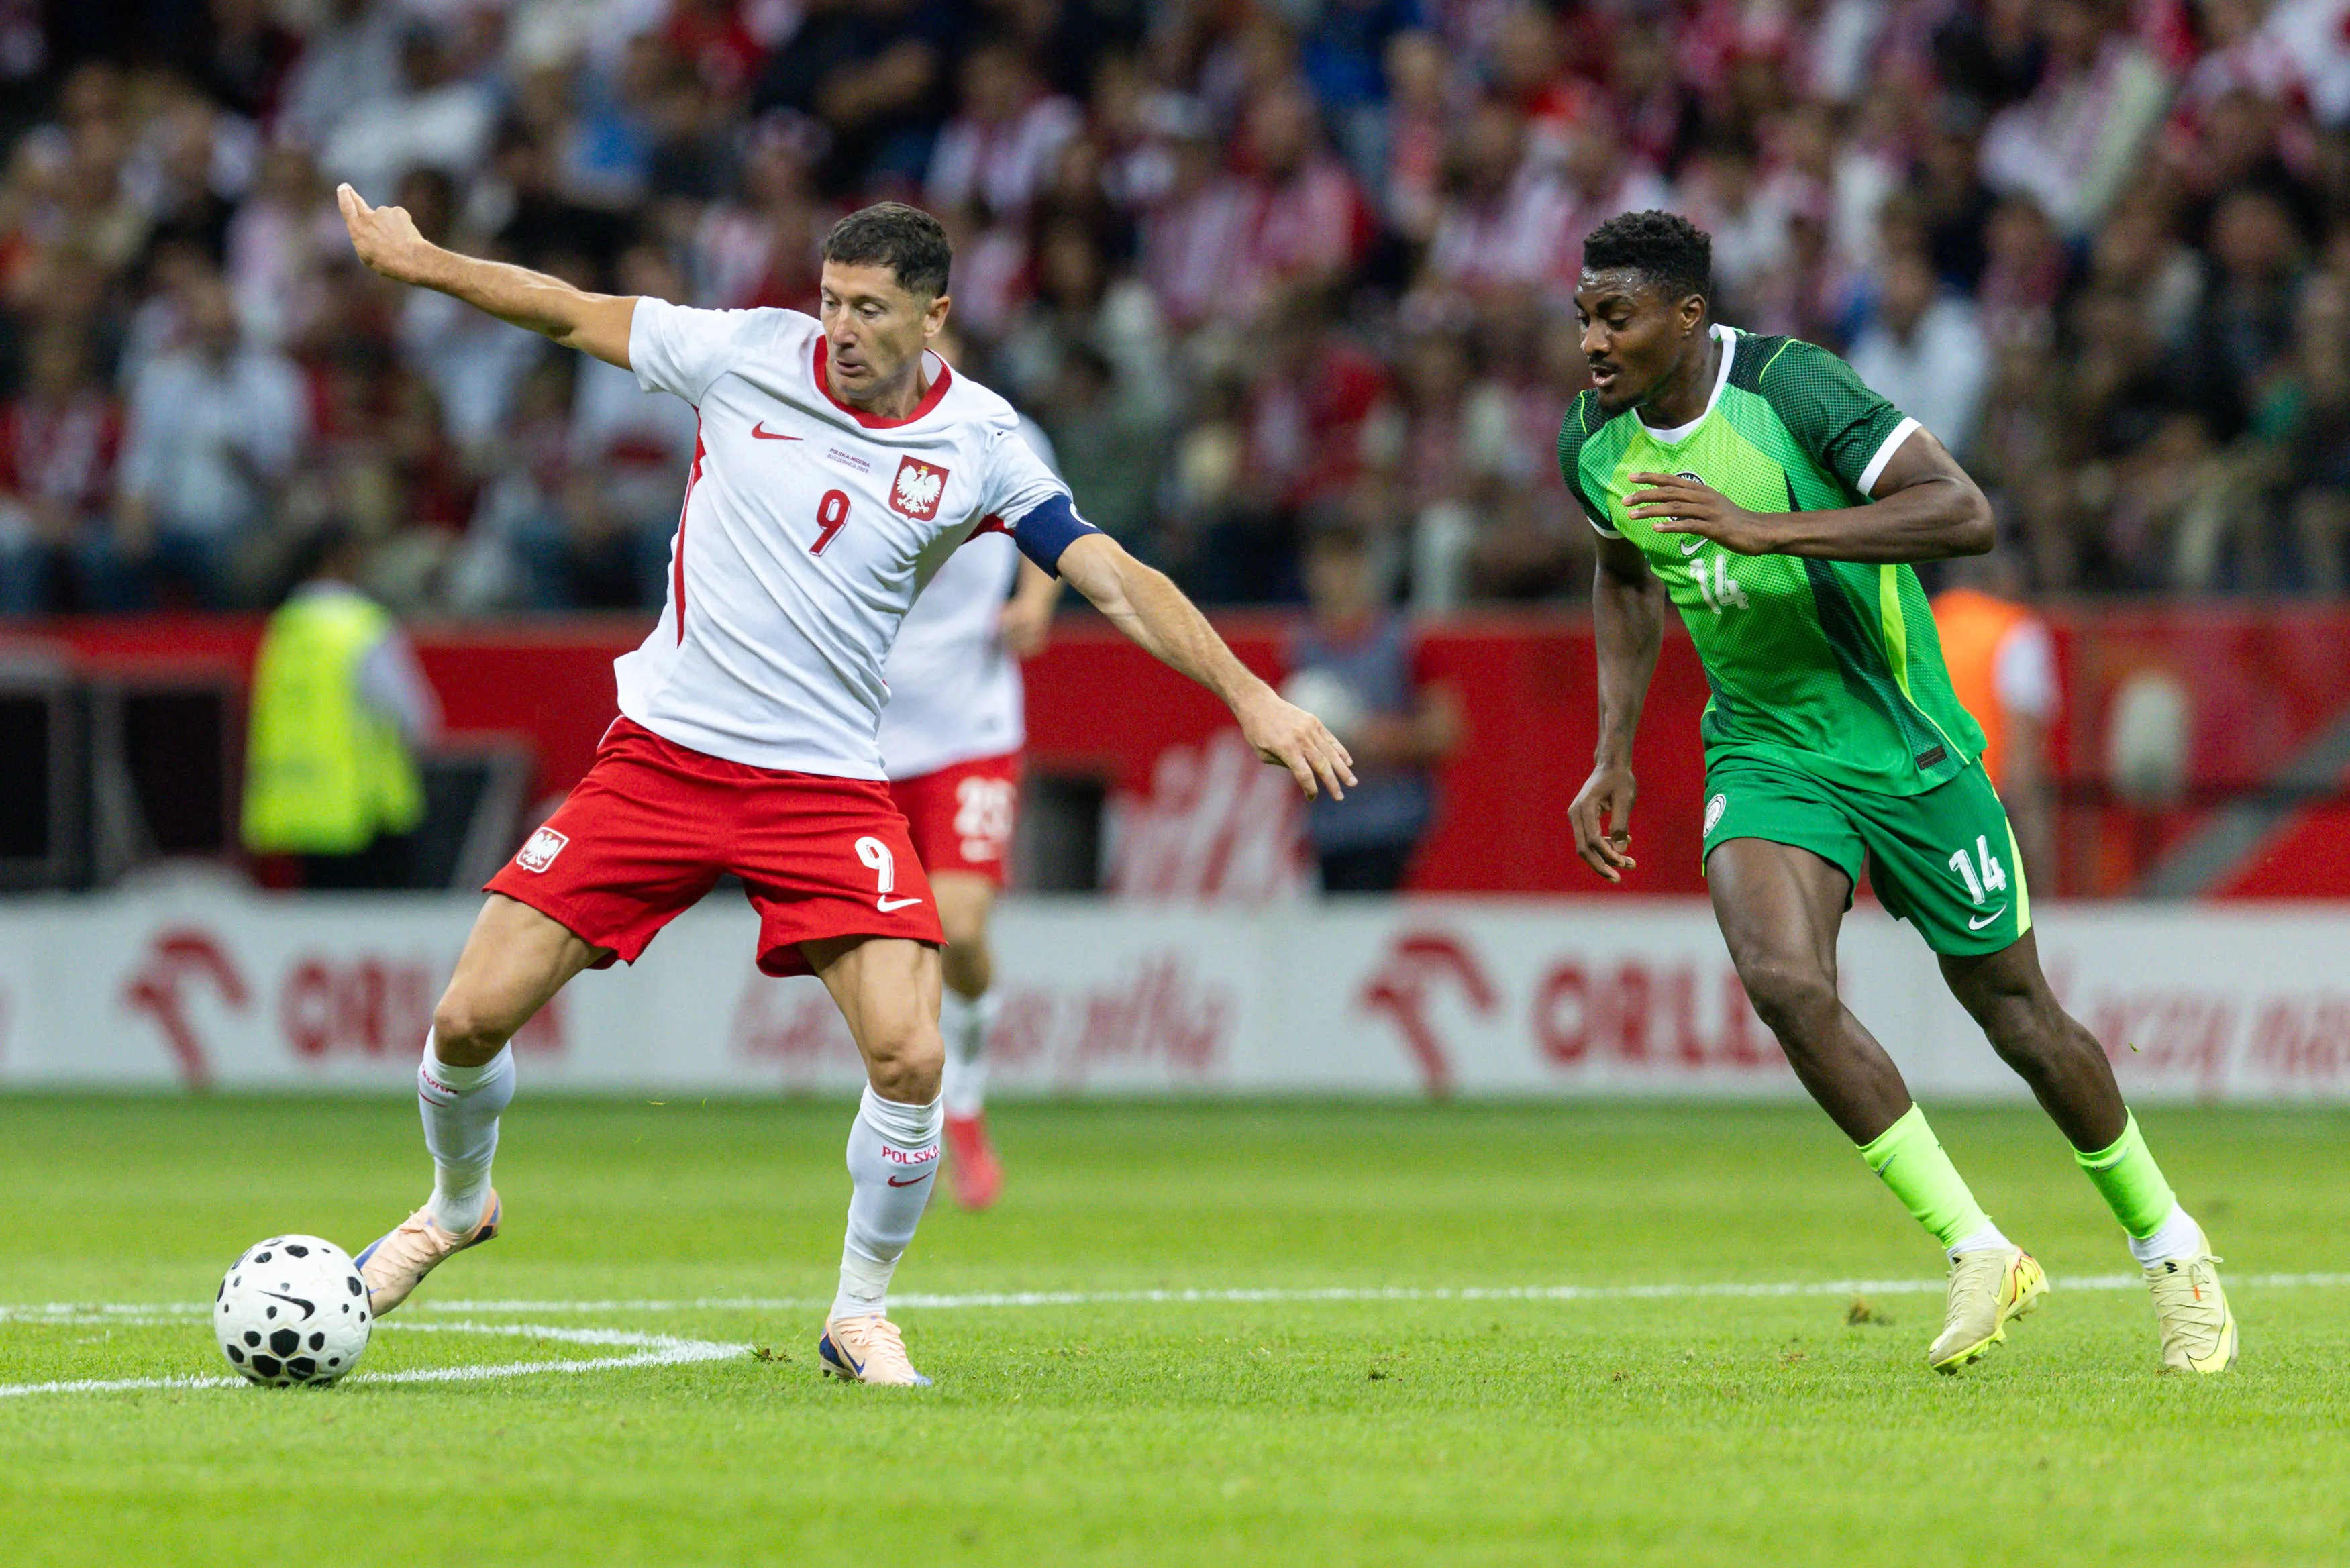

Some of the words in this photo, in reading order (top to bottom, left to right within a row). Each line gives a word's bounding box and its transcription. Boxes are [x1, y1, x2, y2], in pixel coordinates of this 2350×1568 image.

[809, 489, 852, 557] 9
[1689, 554, 1749, 615] 14
[854, 836, 894, 893] 9
[1948, 834, 2006, 905] 14
[882, 1145, 940, 1165] POLSKA
